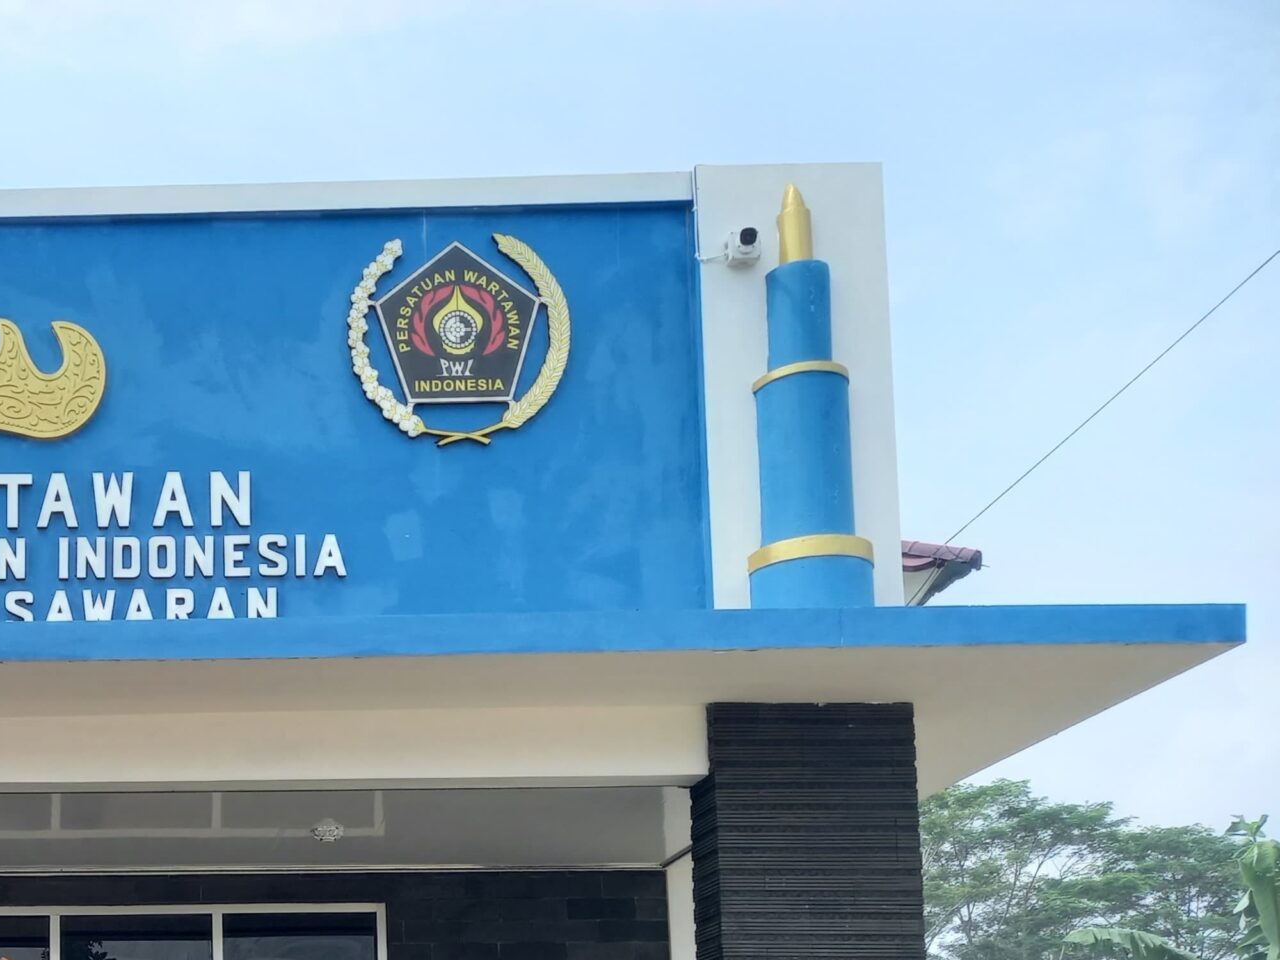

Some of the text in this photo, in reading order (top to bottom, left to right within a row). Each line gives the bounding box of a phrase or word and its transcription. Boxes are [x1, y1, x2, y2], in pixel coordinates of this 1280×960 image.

[396, 270, 520, 352] PERSATUAN WARTAWAN
[436, 358, 473, 376] PWI
[415, 379, 504, 392] INDONESIA
[59, 534, 347, 579] INDONESIA
